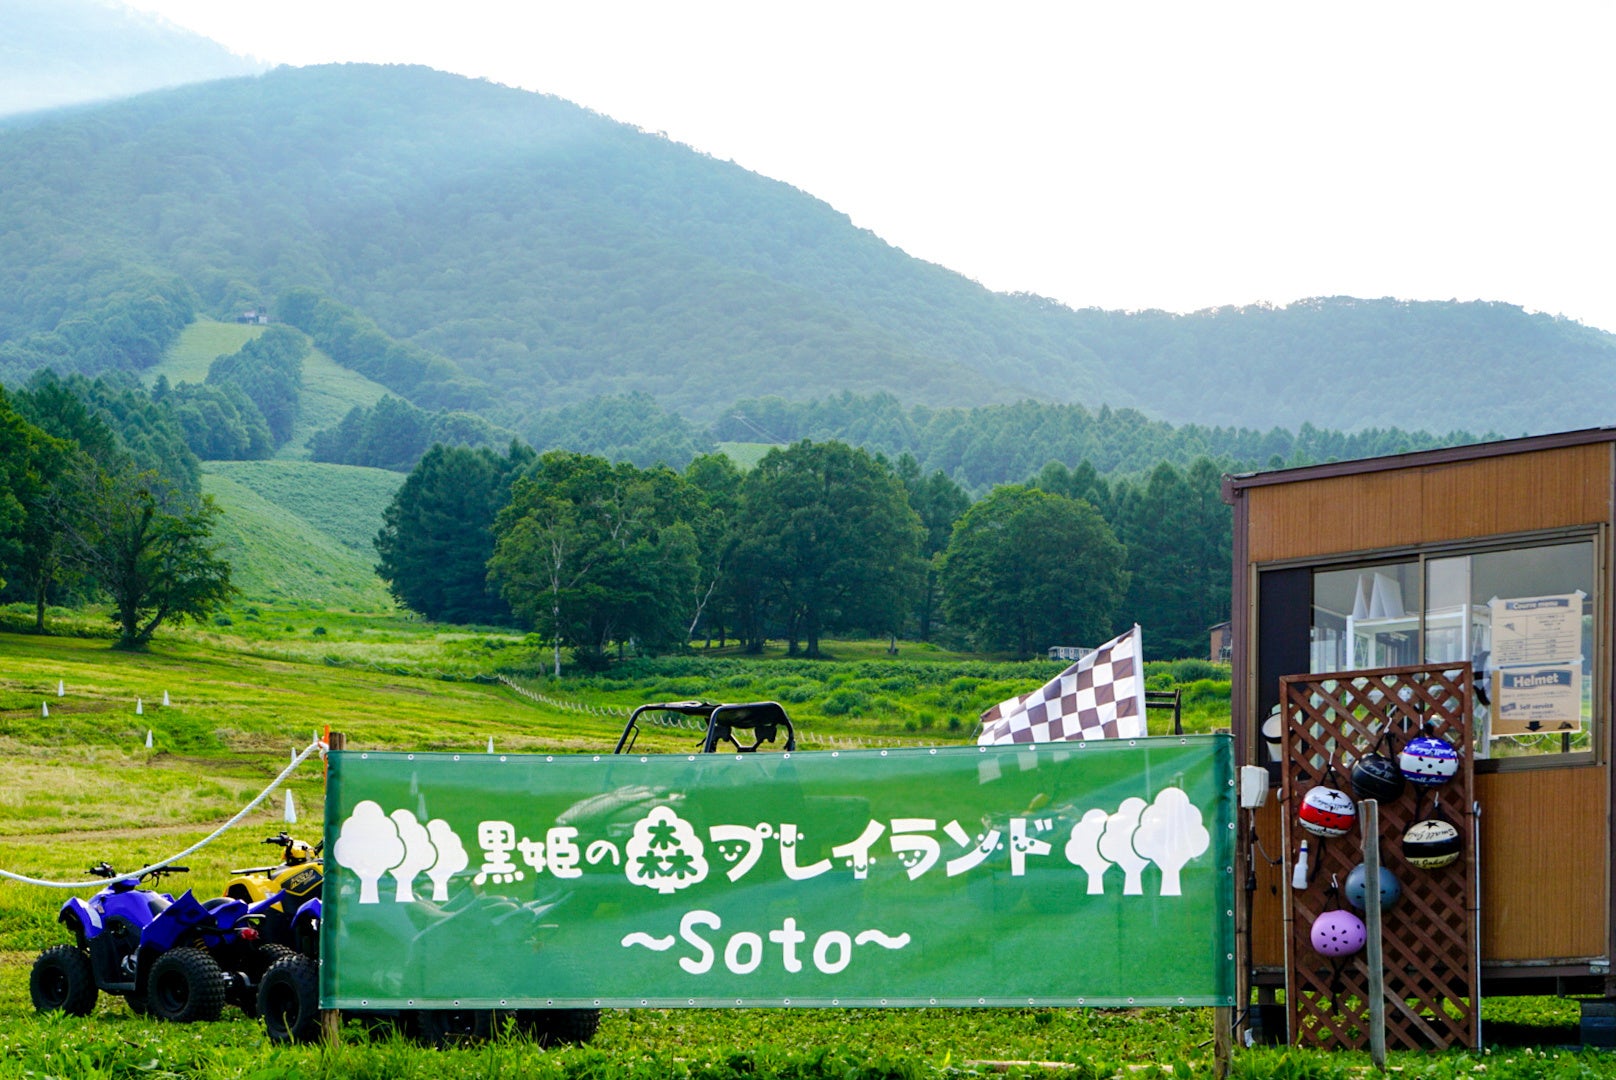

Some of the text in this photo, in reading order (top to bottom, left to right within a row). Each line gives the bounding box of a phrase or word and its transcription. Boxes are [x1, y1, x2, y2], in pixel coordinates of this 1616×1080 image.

[1513, 673, 1559, 688] Helmet
[1520, 703, 1531, 711] Self
[473, 808, 1053, 892] 黒姫の森プレイランド
